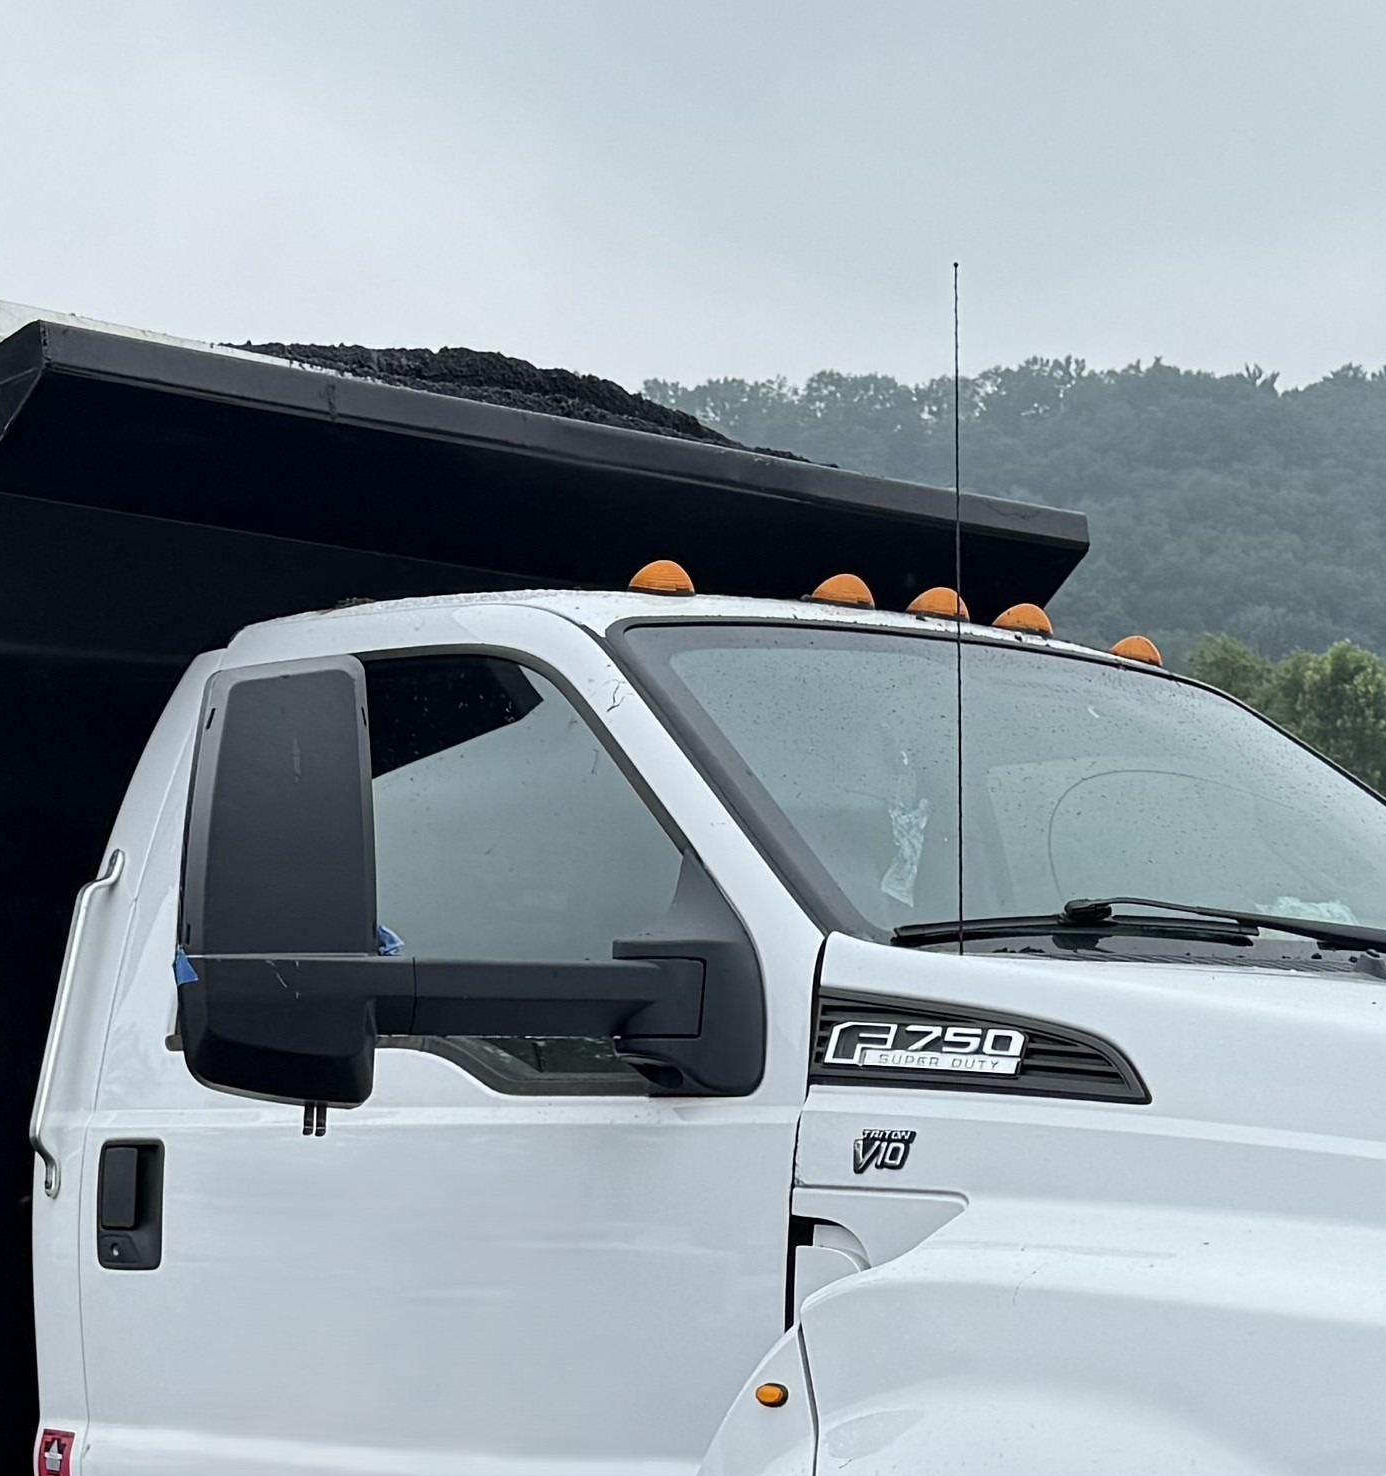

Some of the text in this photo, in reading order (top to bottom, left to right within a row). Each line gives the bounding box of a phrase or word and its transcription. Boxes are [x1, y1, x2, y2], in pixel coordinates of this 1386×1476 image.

[878, 1053, 1000, 1070] SUPER DUTY
[863, 1129, 912, 1140] TRITON
[854, 1140, 906, 1172] V10
